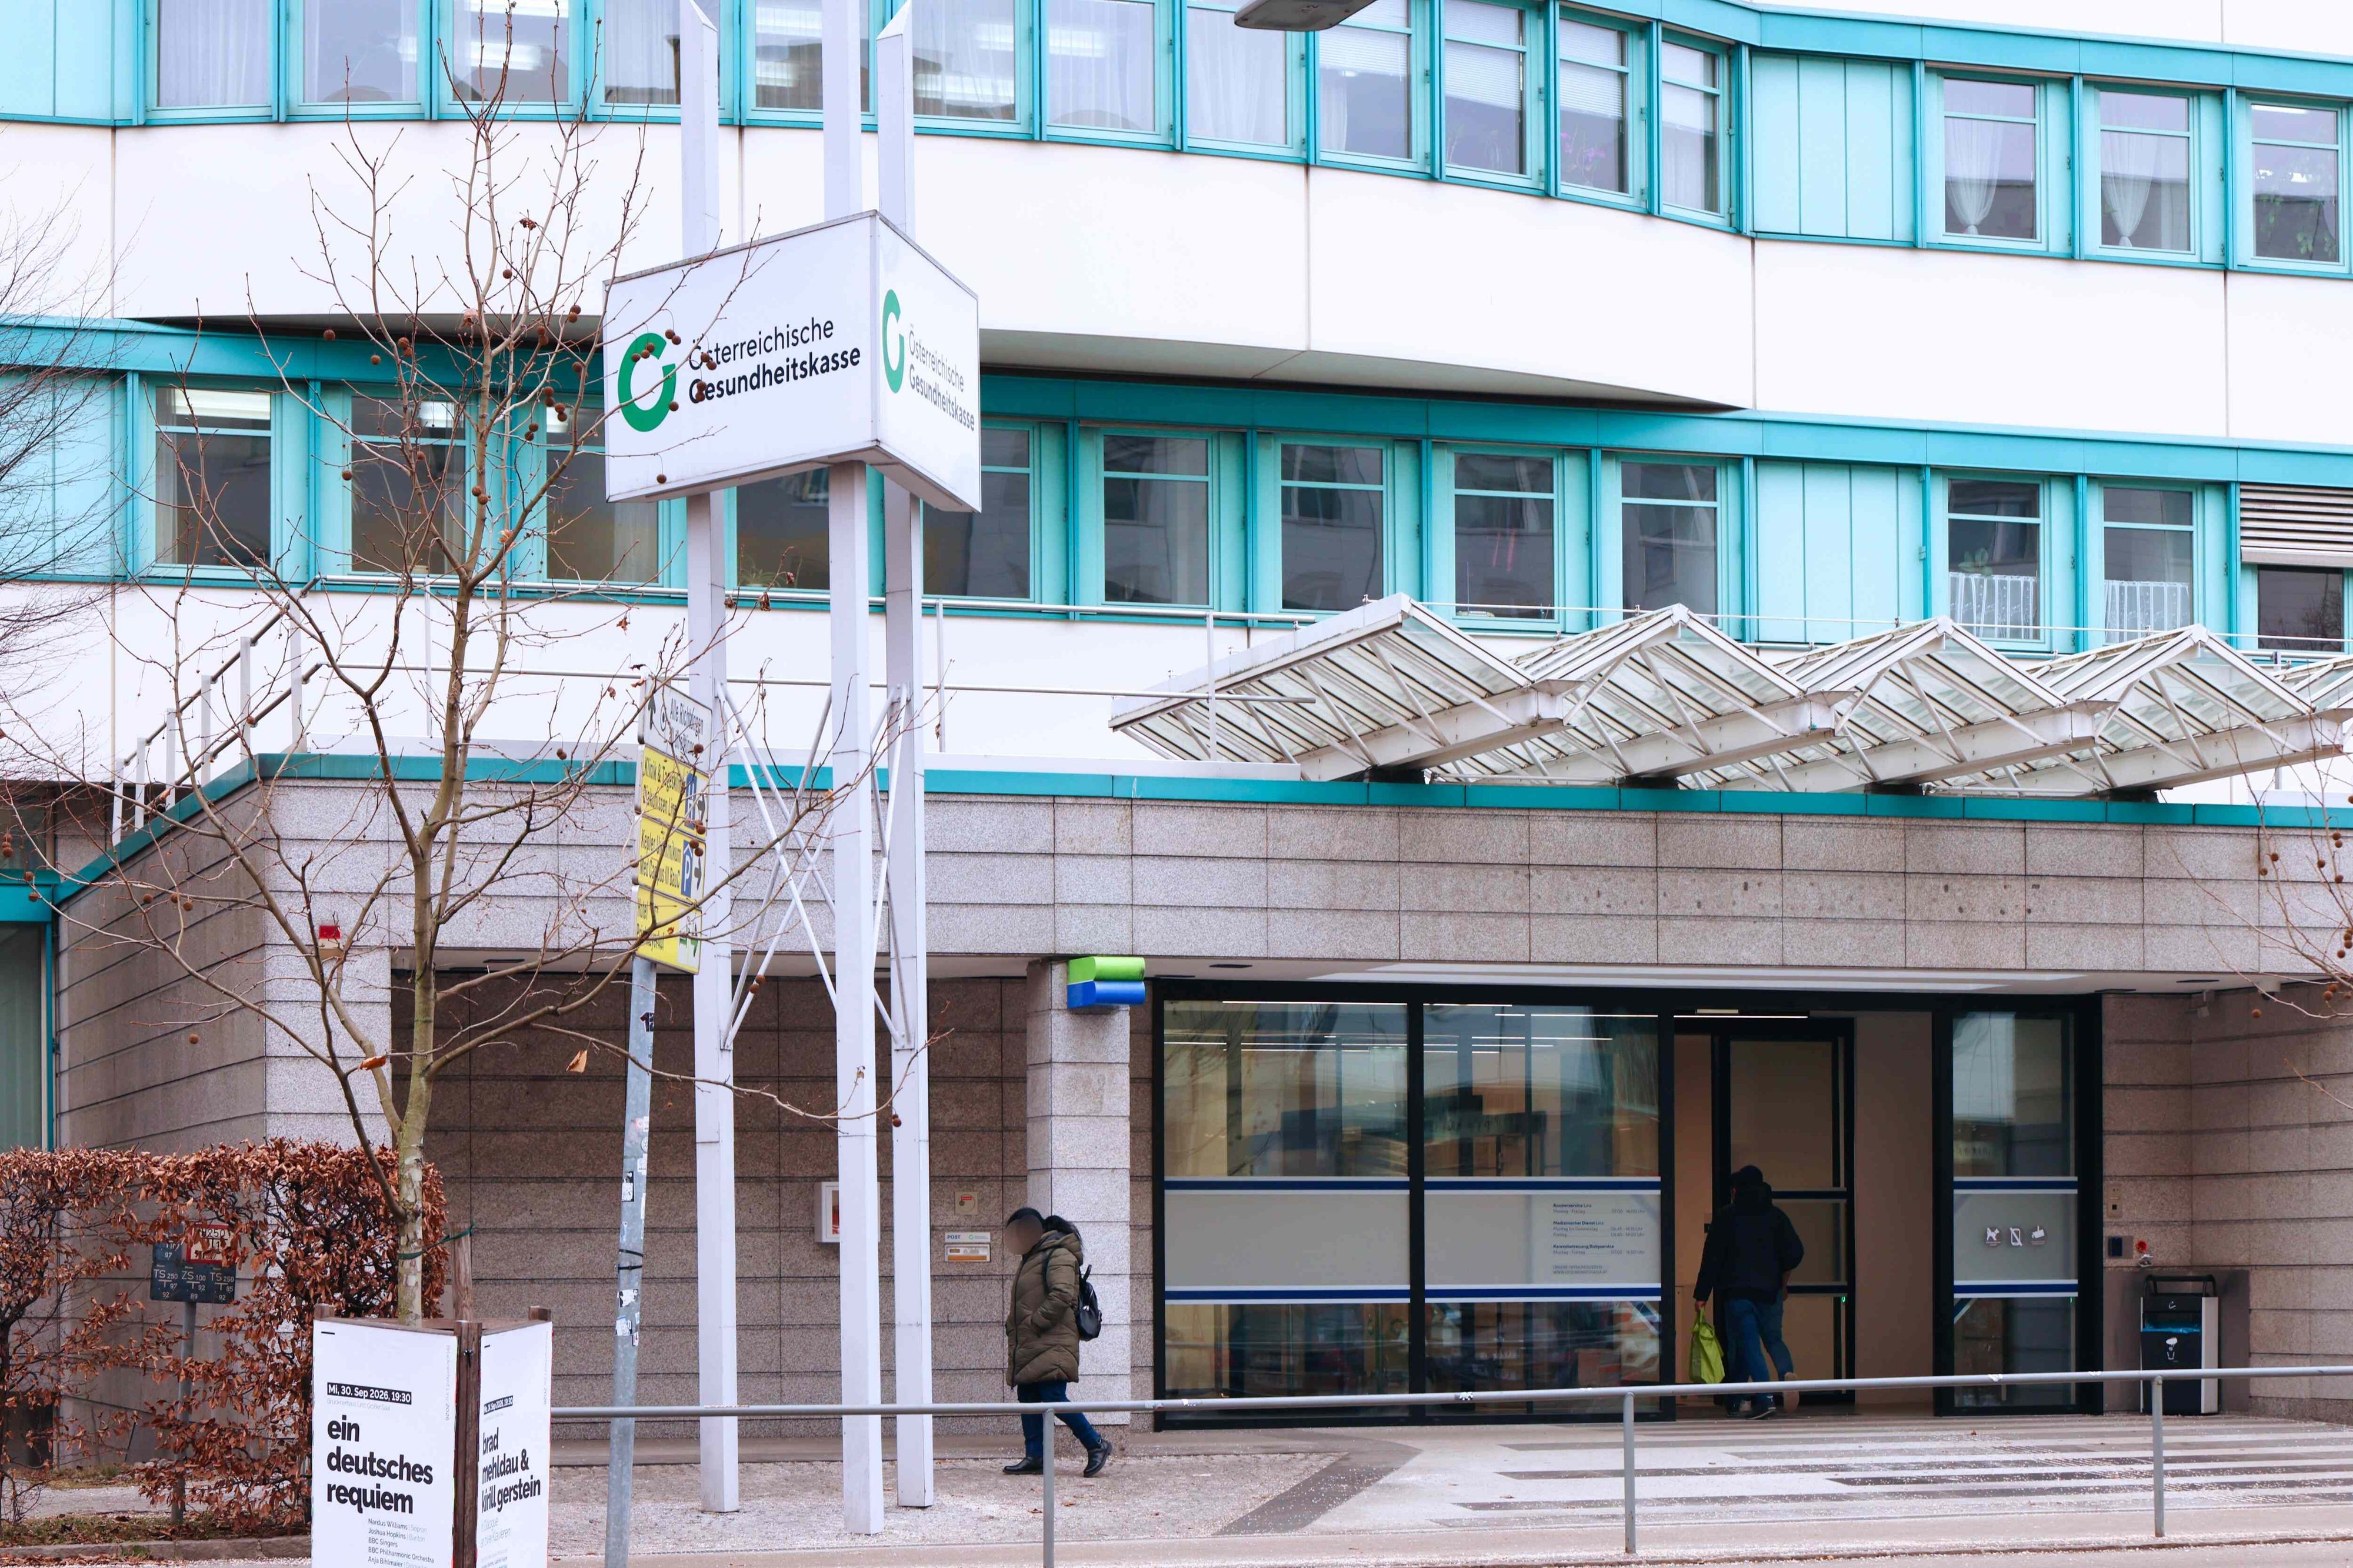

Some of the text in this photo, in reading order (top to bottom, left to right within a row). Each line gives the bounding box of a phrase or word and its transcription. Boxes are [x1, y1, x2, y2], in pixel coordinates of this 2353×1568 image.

[909, 323, 964, 393] Österreichische
[909, 368, 975, 432] Gesundheitskasse
[670, 698, 679, 722] Alle
[679, 703, 704, 736] Richtungen
[645, 756, 685, 792] Klinik & Tagesklin
[668, 798, 677, 817] Lin
[641, 829, 655, 854] Kepler
[638, 899, 648, 920] Hotel
[154, 1269, 166, 1279] TS
[181, 1271, 194, 1280] ZS
[210, 1272, 222, 1281] TS
[328, 1384, 411, 1403] Mi, 30. Sep 2026, 19:30
[327, 1414, 359, 1442] ein
[482, 1427, 499, 1456] brad
[326, 1446, 434, 1485] deutsches
[482, 1449, 529, 1485] mehldau &
[326, 1484, 414, 1514] requiem
[481, 1475, 541, 1514] kirill gerstein
[368, 1519, 386, 1527] Nardus
[386, 1520, 408, 1530] Williams
[368, 1528, 385, 1536] Joshua
[386, 1530, 406, 1540] Hopkins
[368, 1537, 398, 1548] BBC Singers
[368, 1556, 379, 1564] Anja
[379, 1557, 403, 1567] Bihlmaier
[379, 1548, 411, 1560] Philharmonic
[411, 1553, 434, 1564] Orchestra
